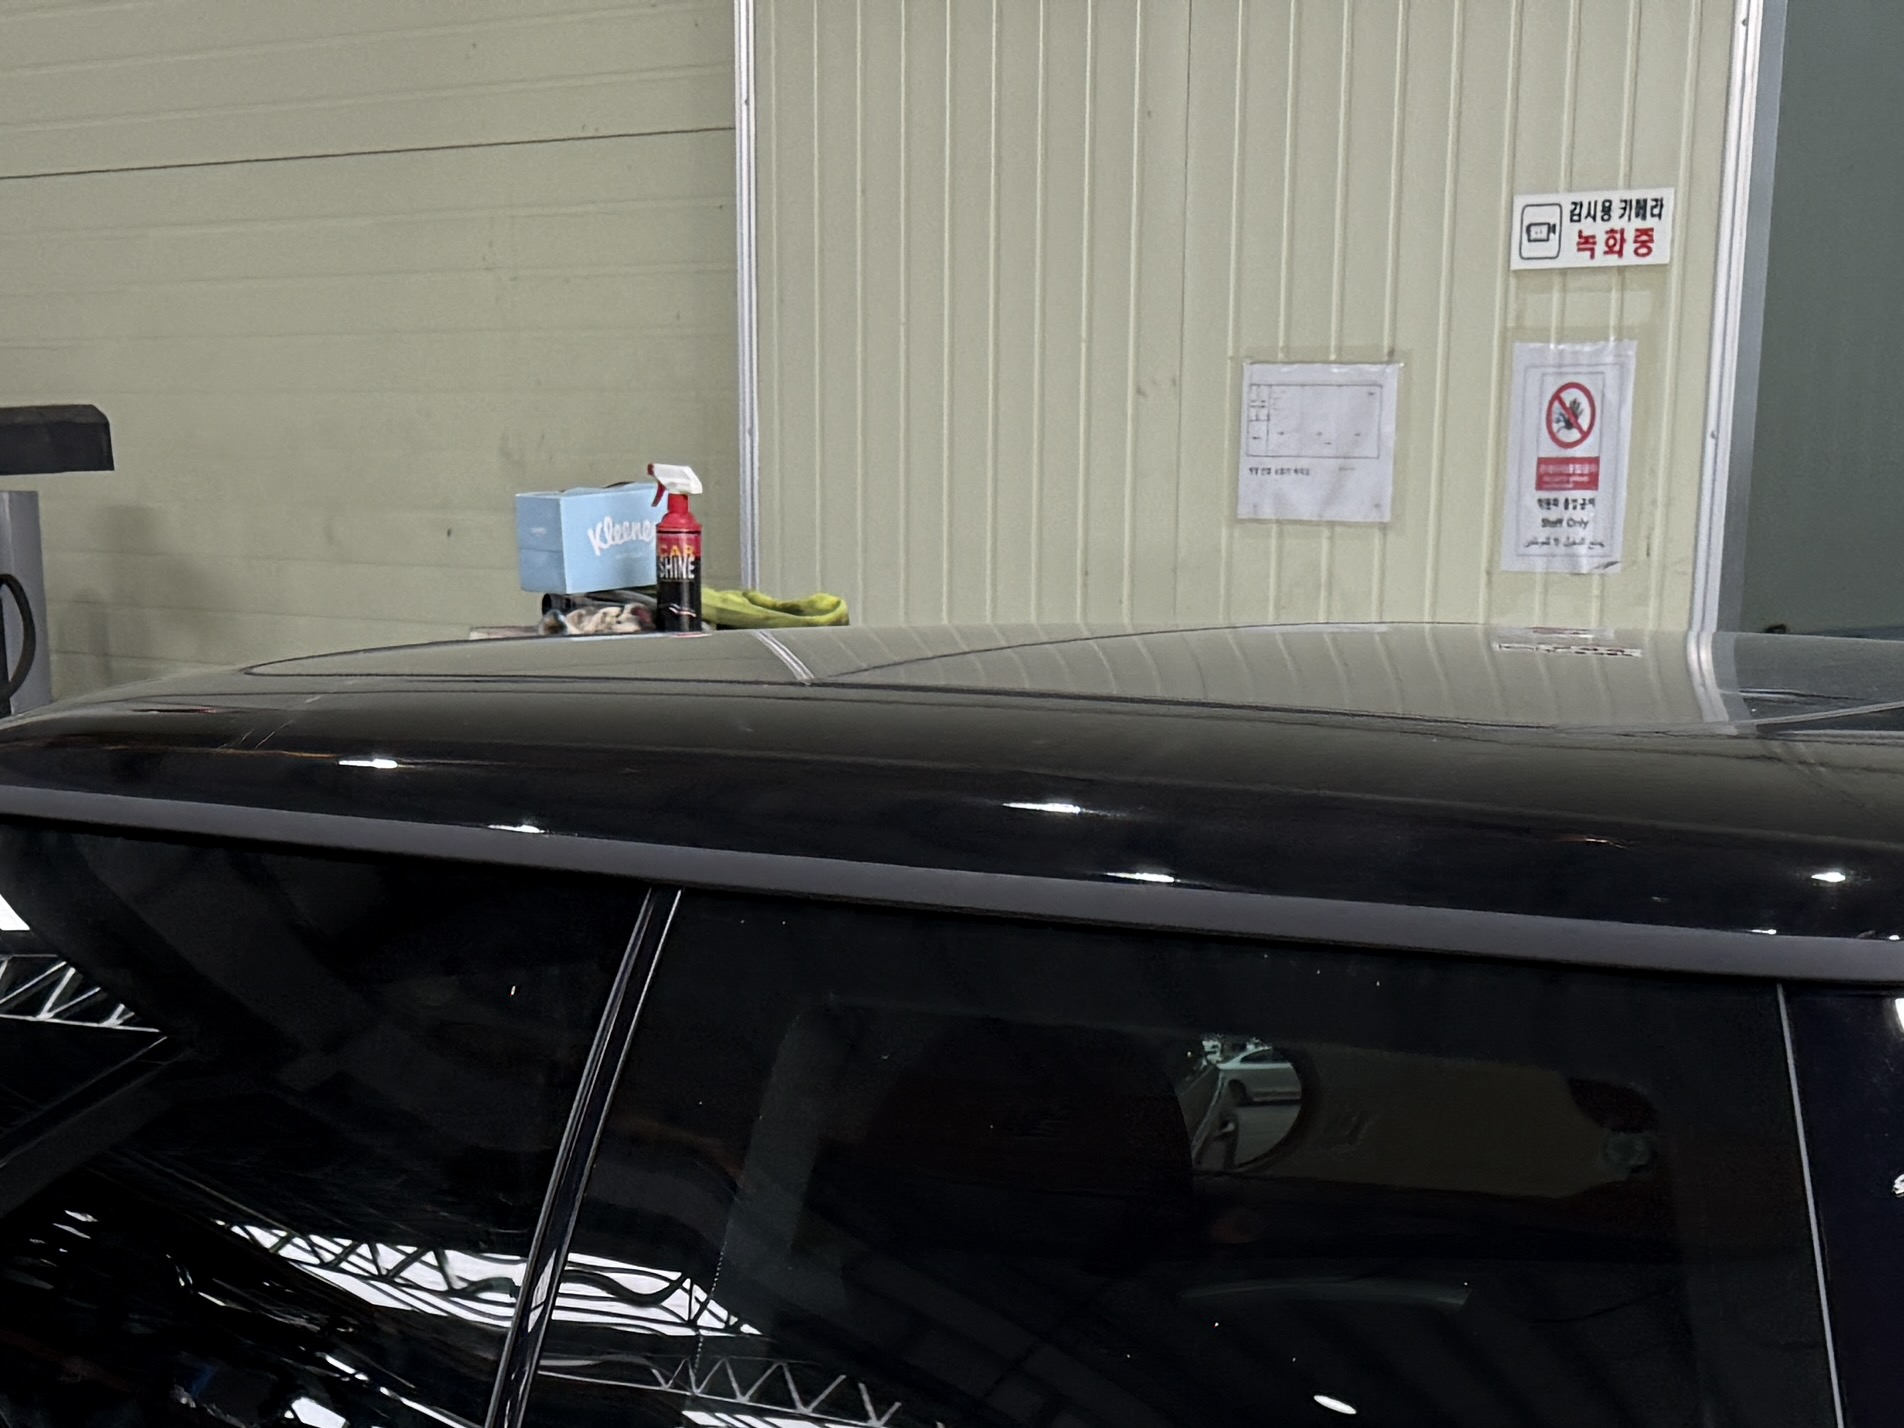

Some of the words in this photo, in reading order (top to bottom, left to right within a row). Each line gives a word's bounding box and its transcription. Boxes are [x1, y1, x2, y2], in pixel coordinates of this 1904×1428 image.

[1570, 199, 1613, 223] 감시용
[1618, 196, 1664, 222] 카메라
[1576, 227, 1655, 260] 녹화중
[587, 516, 656, 556] Kleene
[658, 544, 695, 558] CAR
[658, 556, 696, 579] SHINE
